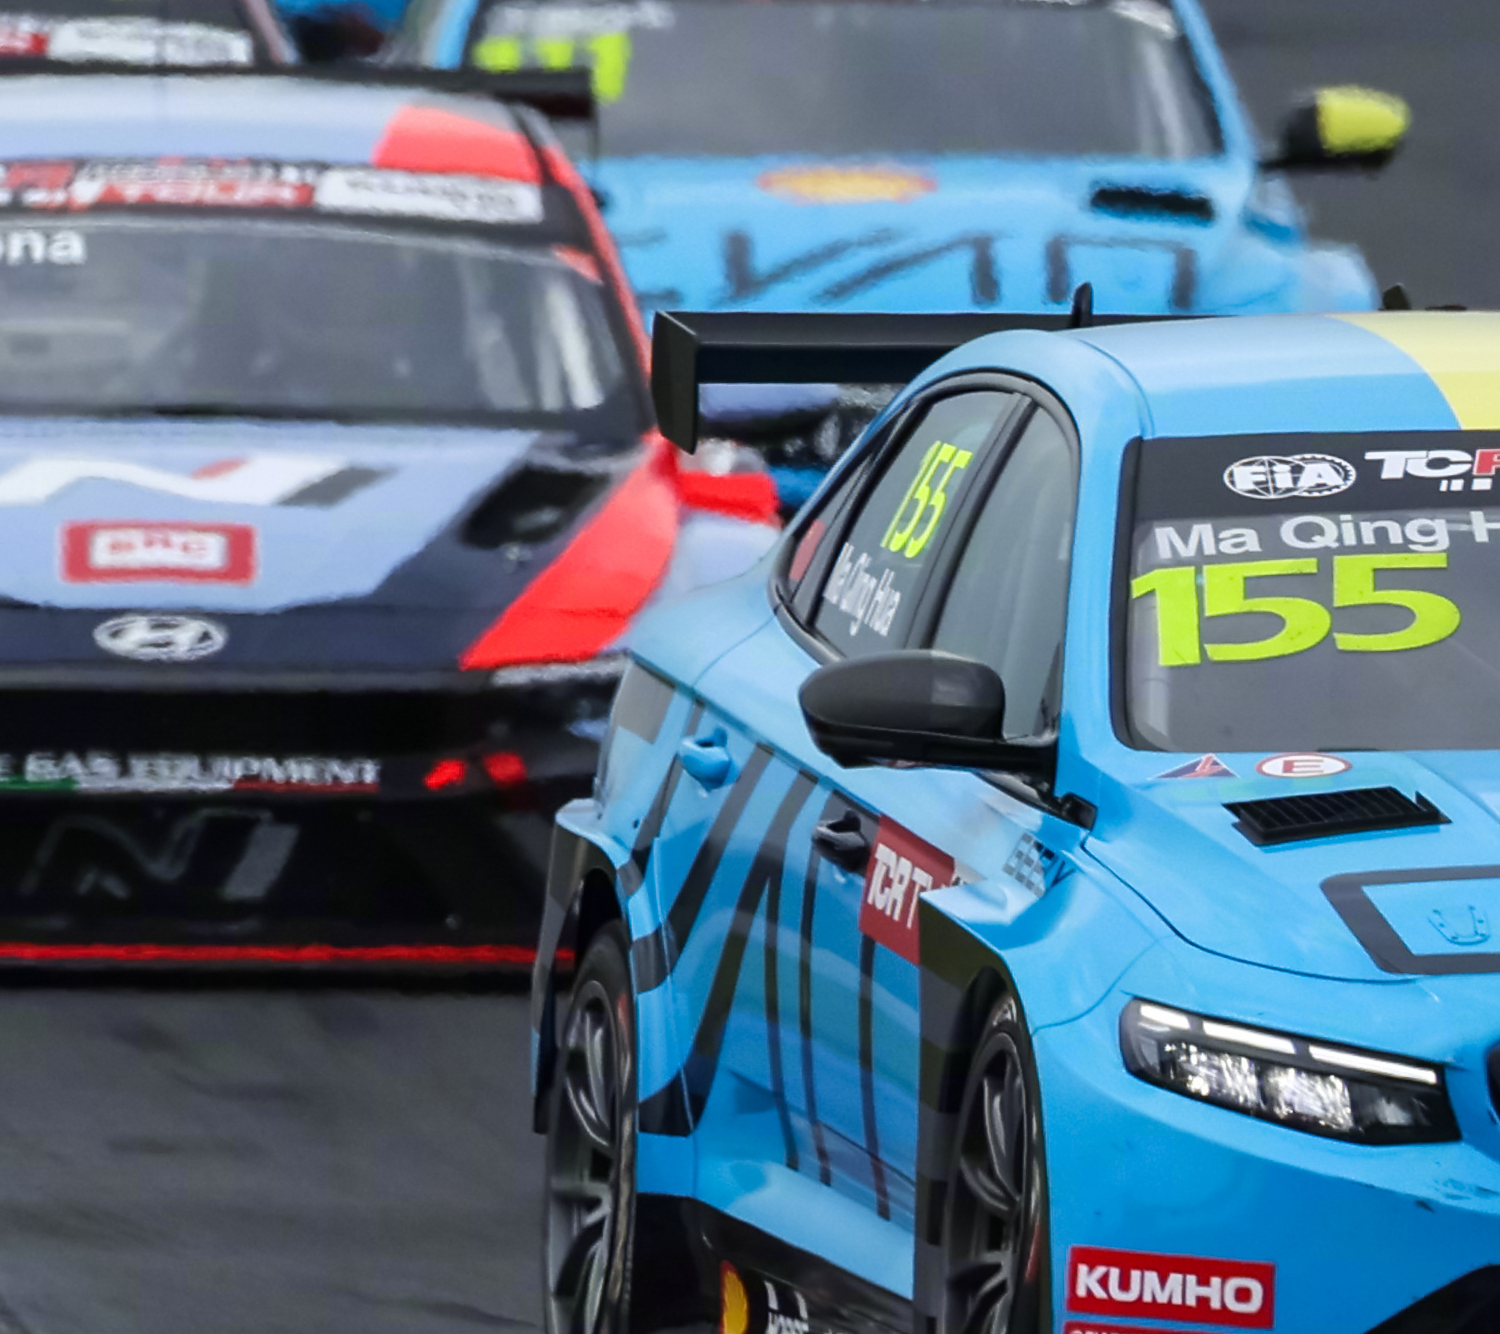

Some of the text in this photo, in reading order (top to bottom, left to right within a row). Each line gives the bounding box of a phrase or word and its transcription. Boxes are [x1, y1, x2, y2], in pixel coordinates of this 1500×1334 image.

[880, 440, 973, 558] 155
[1231, 462, 1347, 490] FIA
[1155, 523, 1263, 560] Ma
[1280, 515, 1451, 552] Qing
[1131, 552, 1461, 667] 155
[867, 843, 913, 922] TCR
[1075, 1263, 1264, 1314] KUMHO
